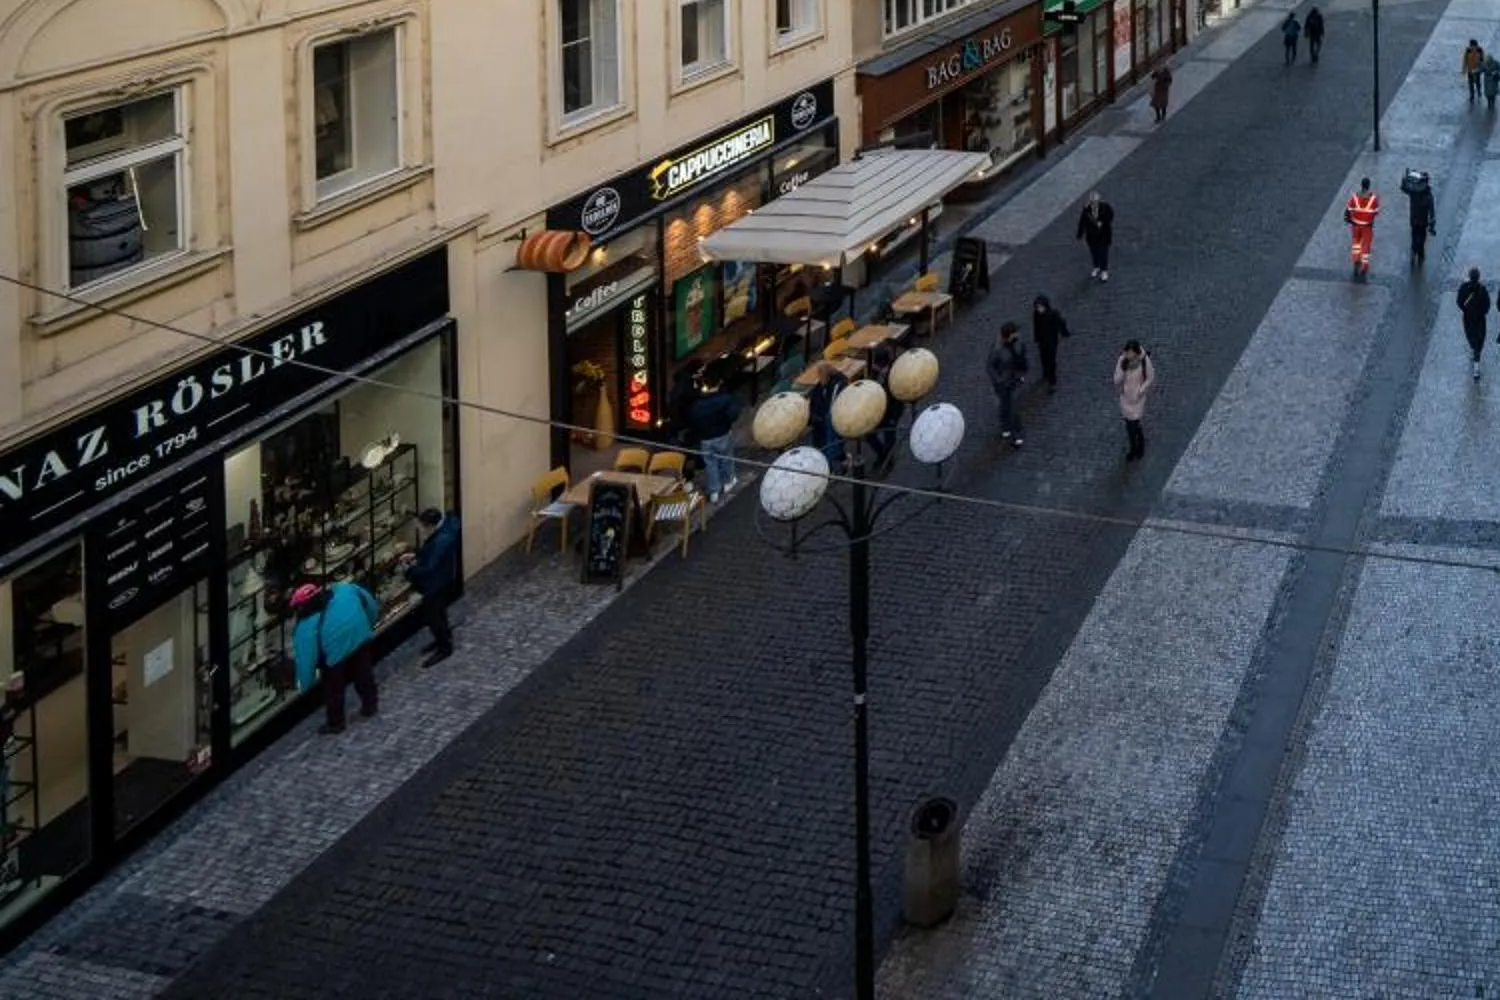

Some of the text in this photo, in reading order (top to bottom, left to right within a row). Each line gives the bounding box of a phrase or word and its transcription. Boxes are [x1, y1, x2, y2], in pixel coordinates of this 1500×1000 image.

[926, 53, 961, 89] BAG
[963, 38, 983, 69] &
[982, 27, 1012, 60] BAG
[132, 320, 328, 439] RÖSLER
[95, 454, 150, 492] since
[155, 425, 199, 459] 1794
